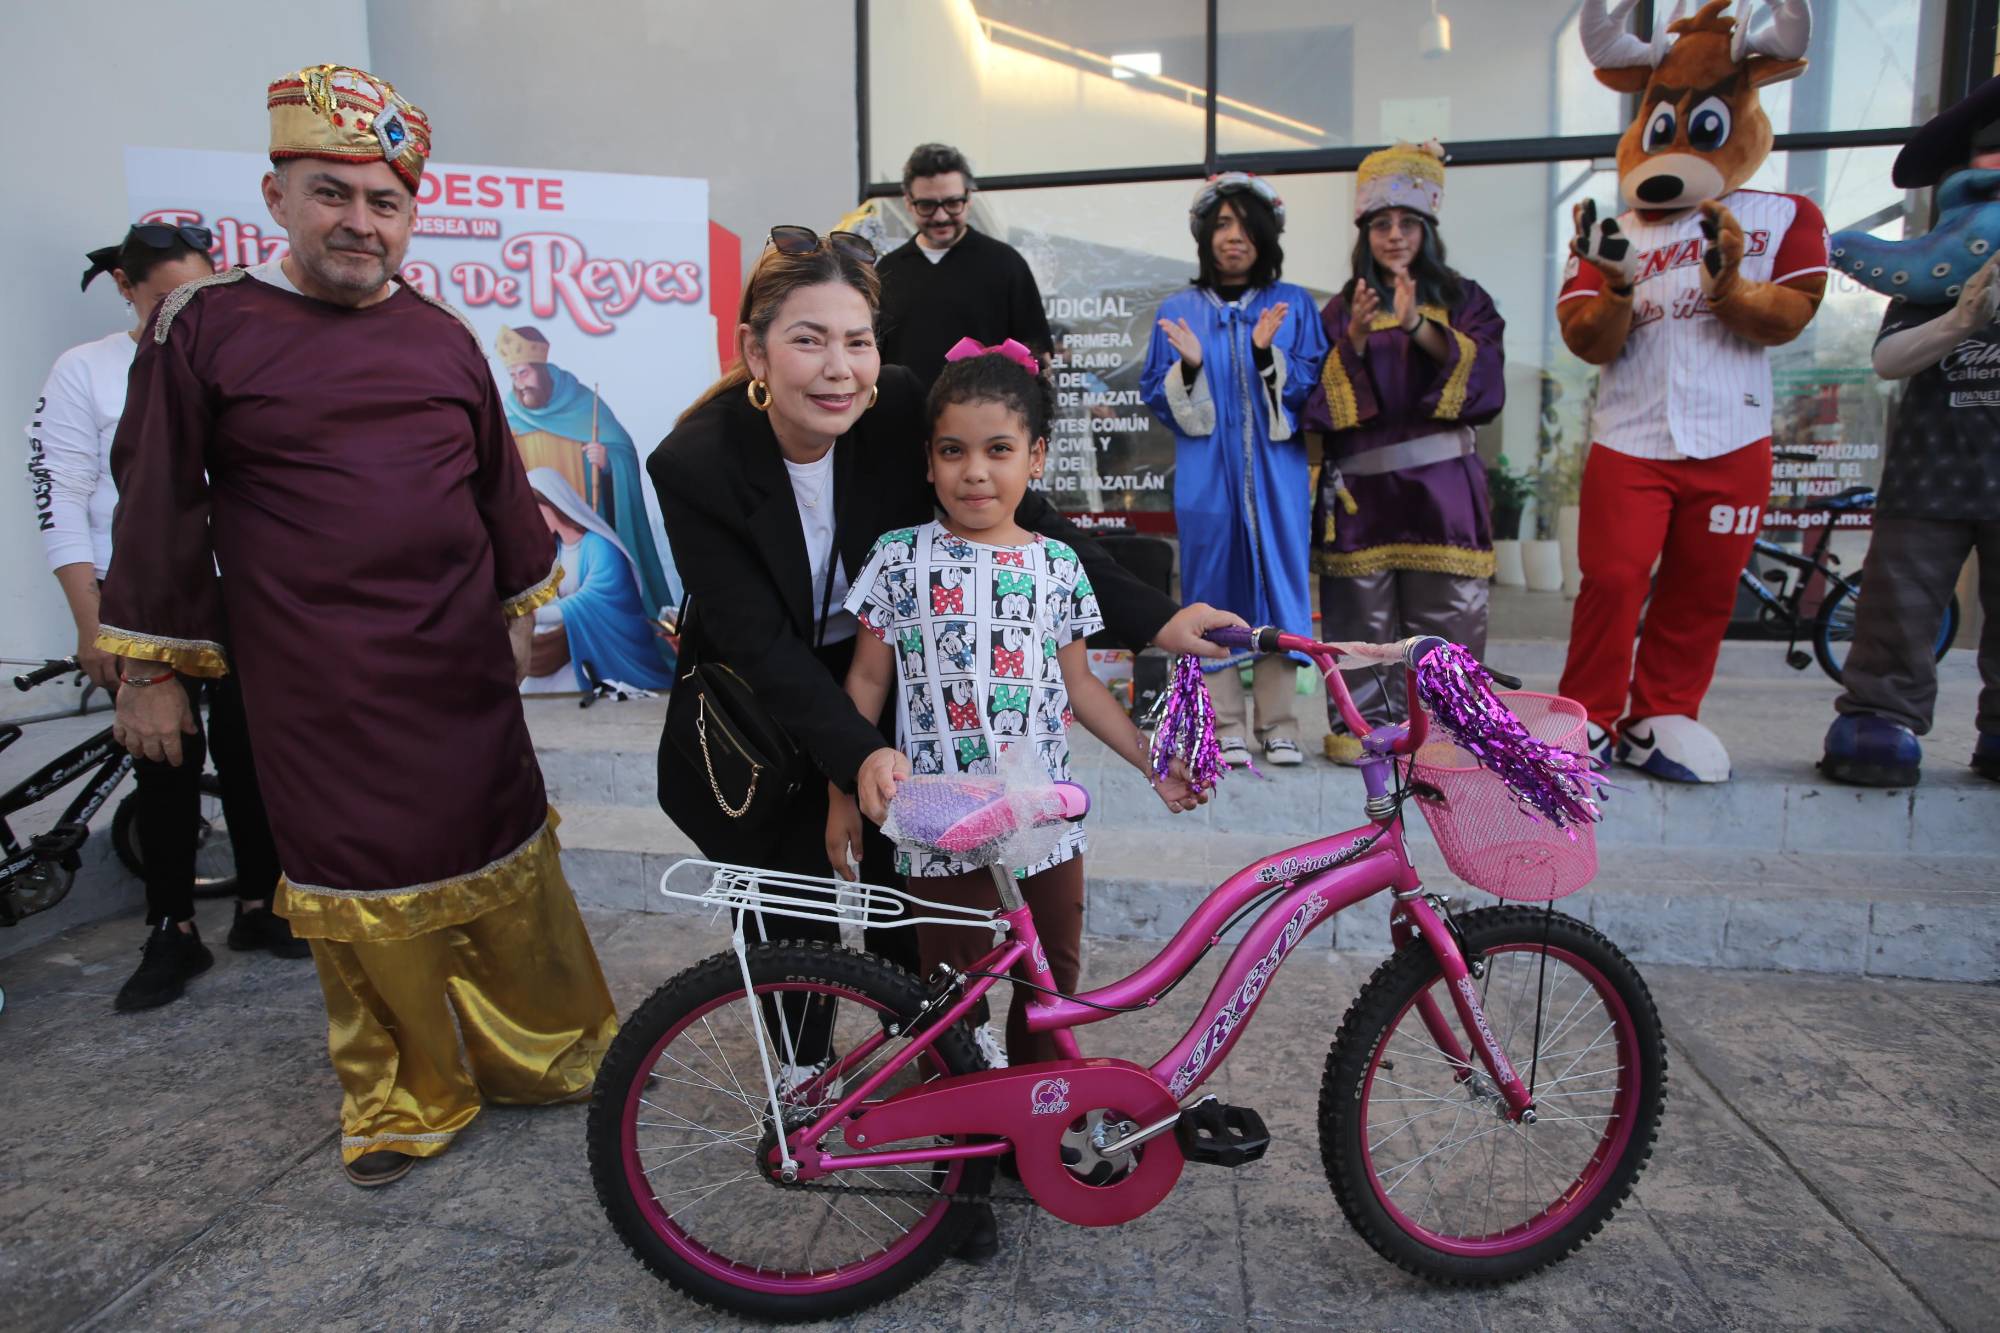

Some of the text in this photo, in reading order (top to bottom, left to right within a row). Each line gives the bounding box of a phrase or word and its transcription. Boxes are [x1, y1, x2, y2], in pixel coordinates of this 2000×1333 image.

[415, 172, 565, 211] OESTE
[471, 220, 498, 237] UN
[452, 262, 522, 308] De
[502, 231, 703, 336] Reyes
[1042, 297, 1134, 320] UDICIAL
[1063, 332, 1134, 349] PRIMERA
[1071, 353, 1122, 368] RAMO
[1059, 372, 1091, 388] DEL
[1057, 390, 1145, 407] DE MAZATL
[1092, 413, 1149, 432] COMÚN
[1057, 437, 1097, 452] CIVIL
[1099, 437, 1112, 451] Y
[1058, 457, 1091, 471] DEL
[1839, 462, 1862, 478] DEL
[1055, 477, 1077, 490] DE
[1080, 472, 1165, 490] MAZATLÁN
[1709, 504, 1760, 535] 911
